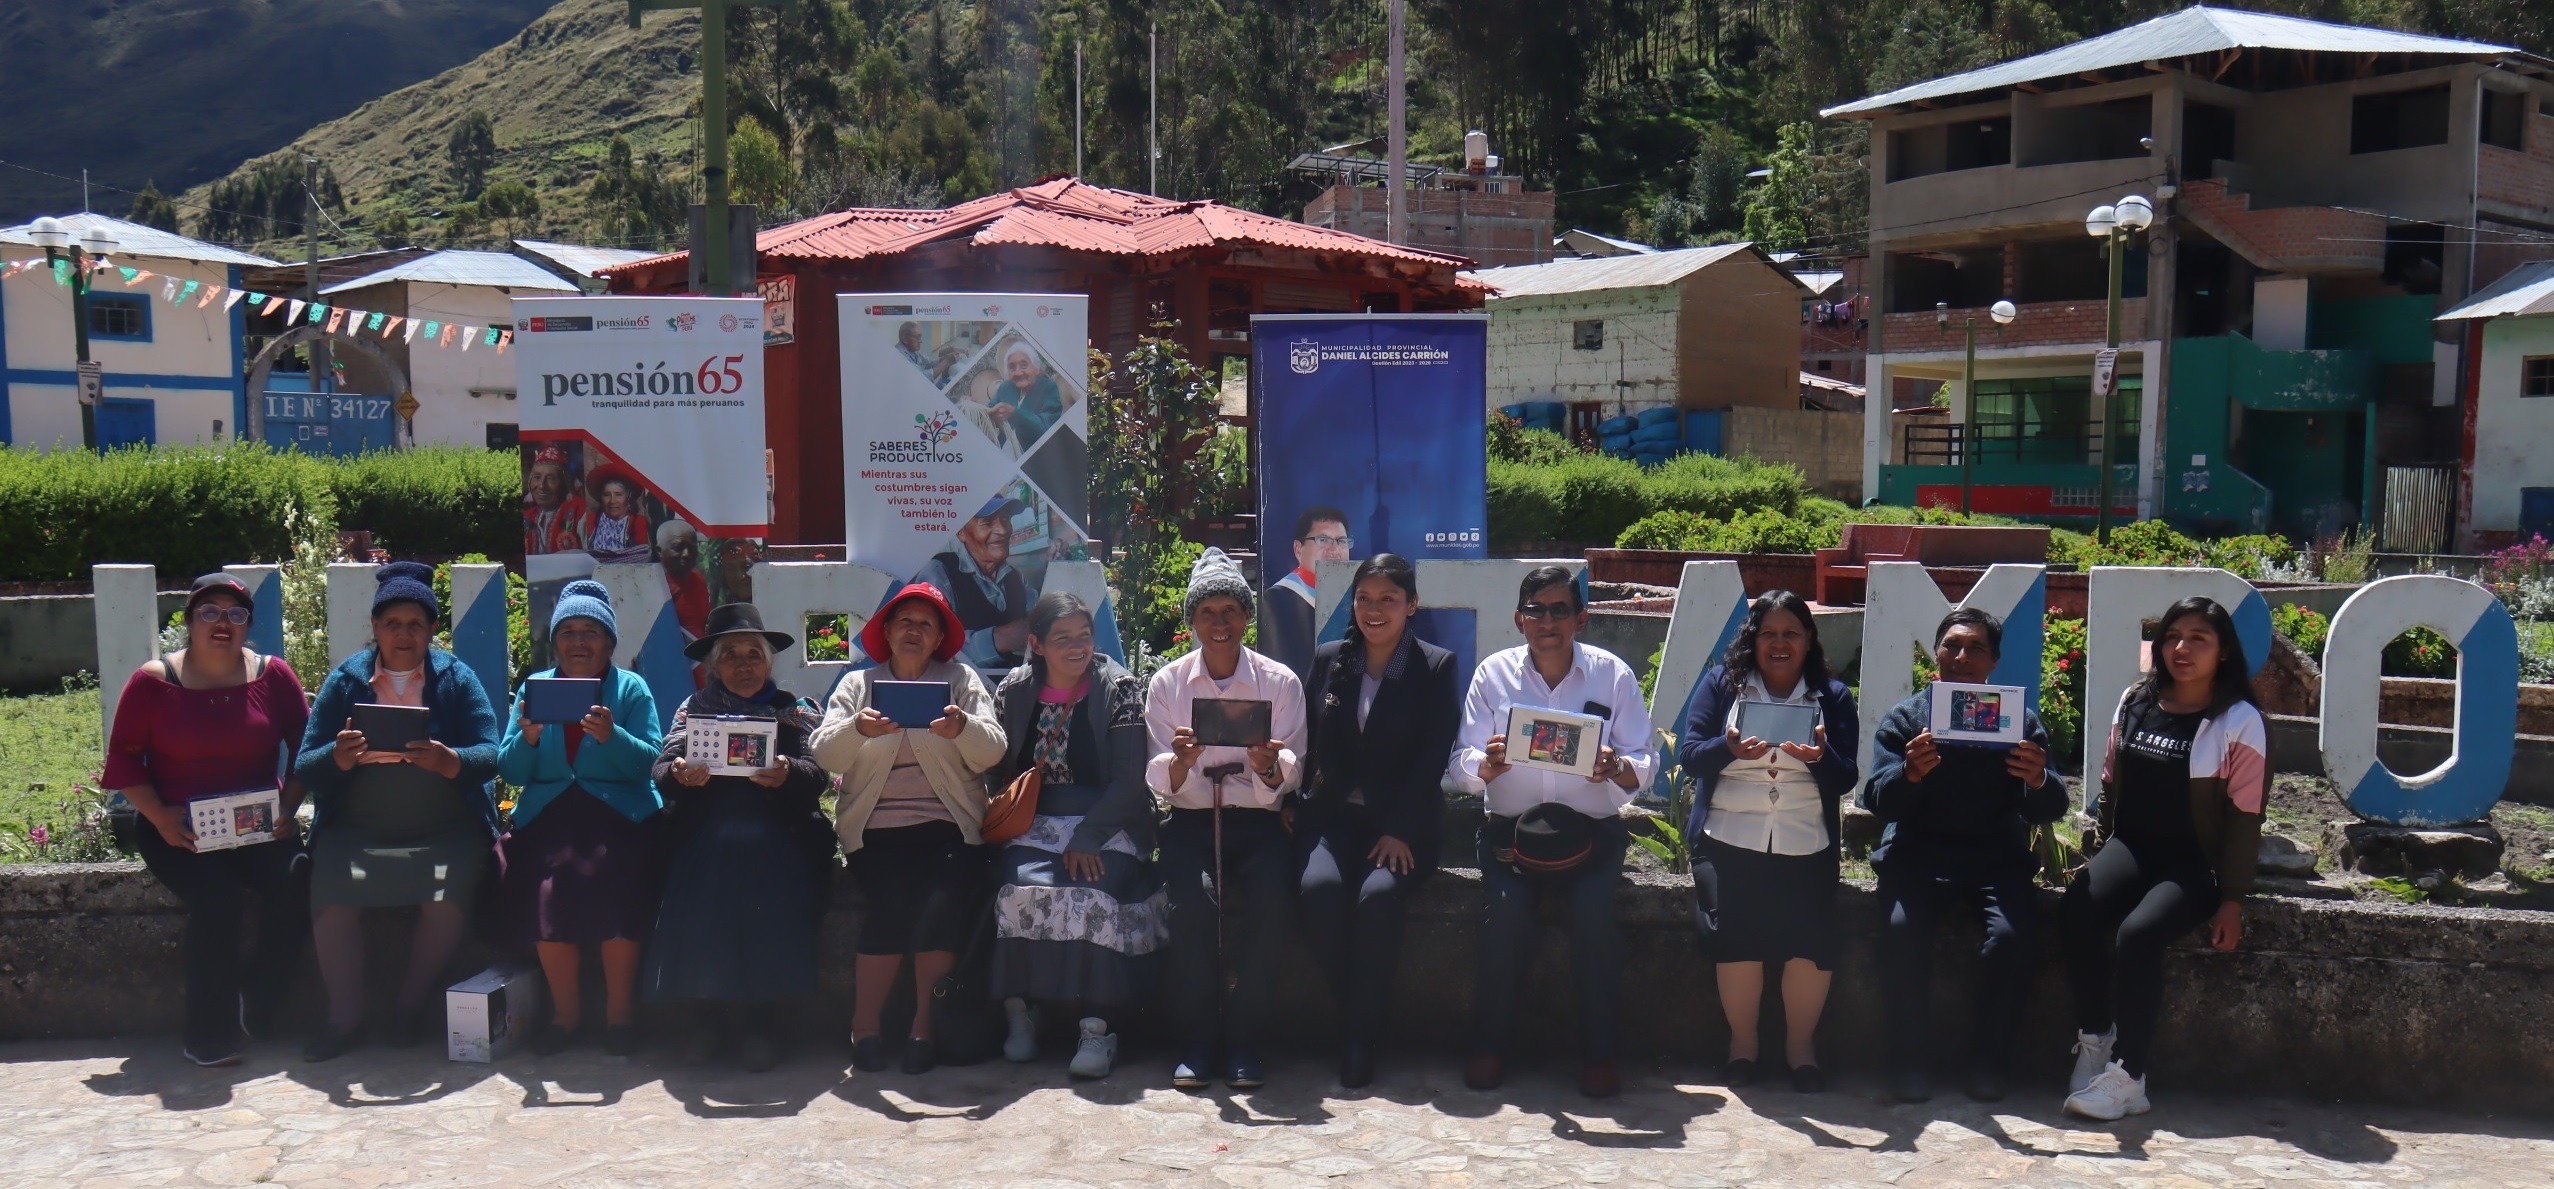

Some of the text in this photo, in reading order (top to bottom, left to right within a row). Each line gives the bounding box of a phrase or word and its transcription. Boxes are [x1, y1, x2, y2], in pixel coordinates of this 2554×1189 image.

[596, 315, 650, 329] pensión65
[1321, 348, 1449, 360] DANIEL ALCIDES CARRIÓN
[541, 353, 744, 406] pensión65
[592, 398, 745, 409] tranquilidad para más peruanos
[331, 399, 392, 420] 34127
[869, 441, 928, 452] SABERES
[869, 452, 964, 463] PRODUCTIVOS
[861, 470, 907, 479] Mientras
[874, 483, 968, 495] costumbres sigan
[887, 497, 918, 506] vivas,
[919, 498, 932, 506] su
[901, 509, 957, 519] también lo
[914, 522, 950, 532] estará.
